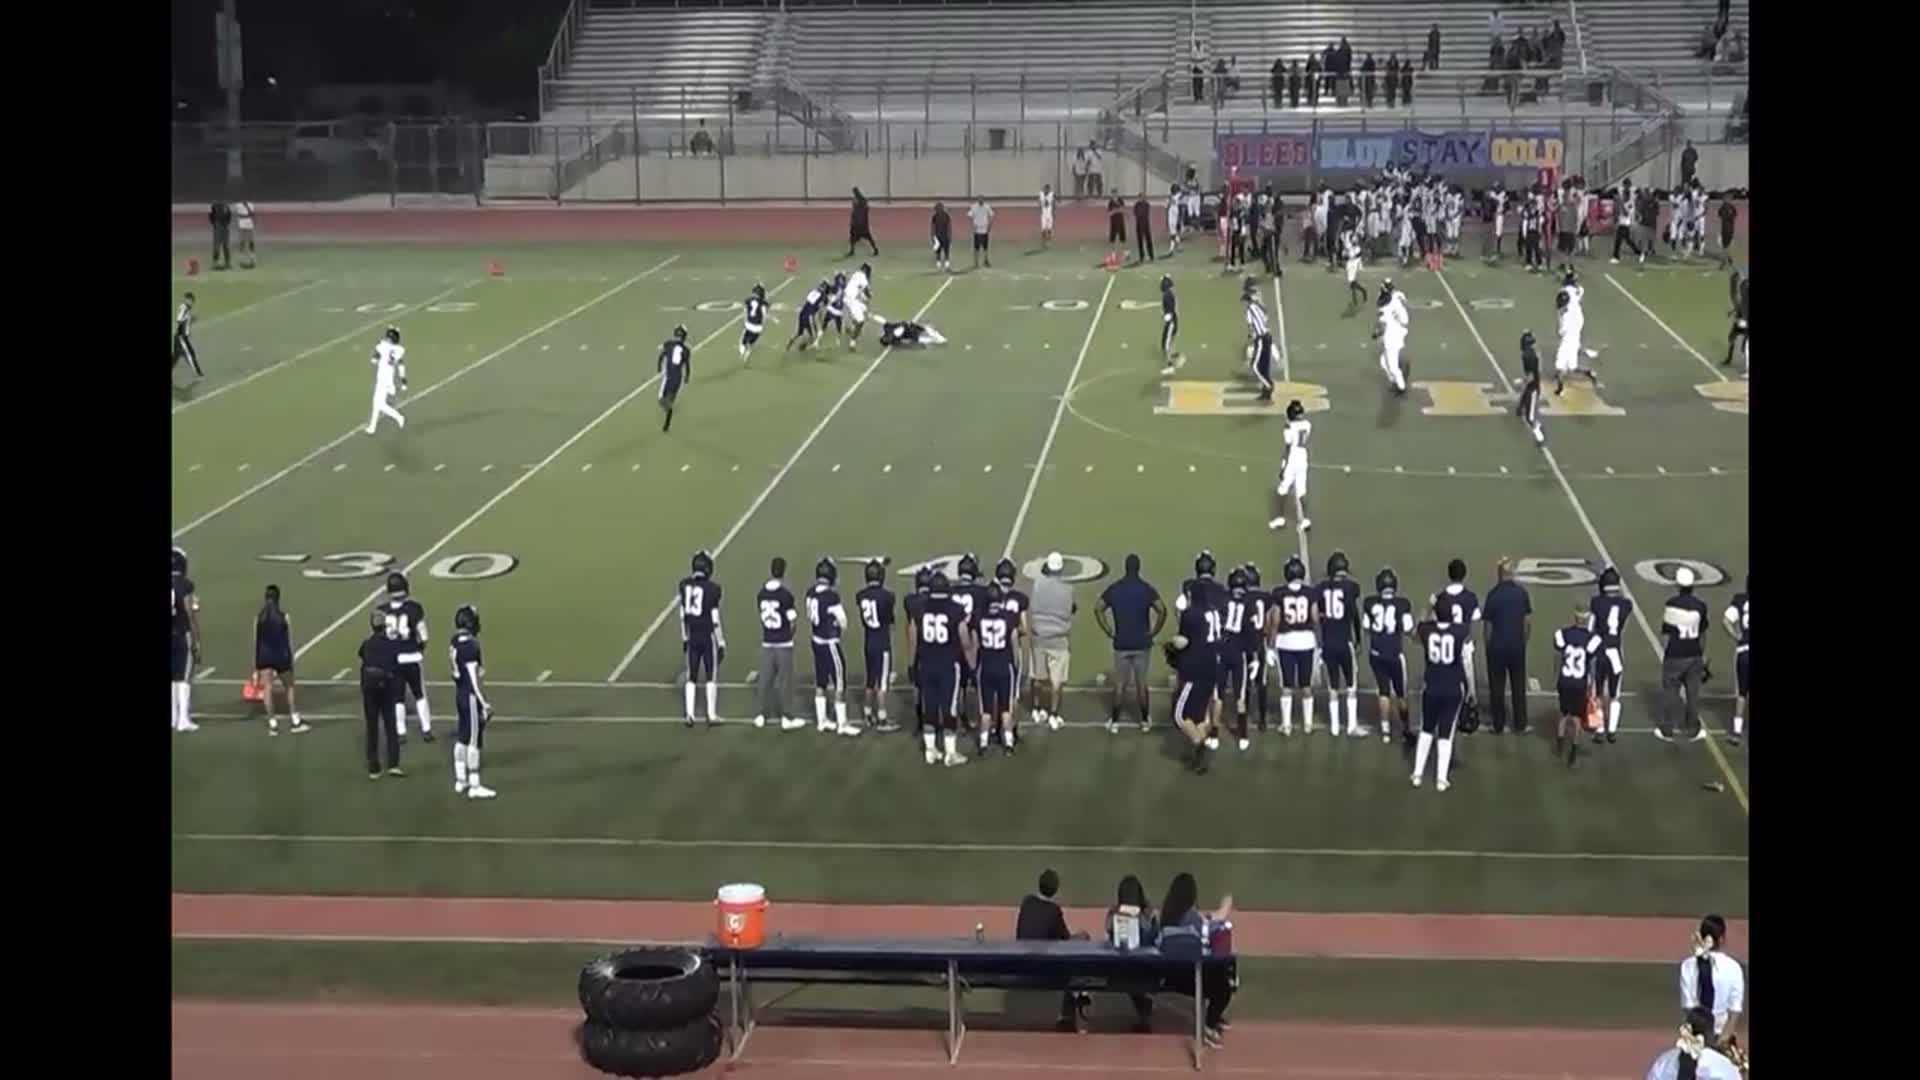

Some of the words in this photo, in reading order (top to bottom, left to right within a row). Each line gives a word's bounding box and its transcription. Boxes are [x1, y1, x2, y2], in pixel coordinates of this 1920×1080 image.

[1403, 139, 1481, 164] STAY
[685, 585, 704, 616] 13
[760, 600, 782, 629] 25
[861, 599, 881, 628] 21
[1283, 596, 1308, 625] 58
[1323, 589, 1345, 620] 16
[922, 613, 949, 643] 66
[980, 618, 1006, 649] 52
[1371, 603, 1397, 634] 34
[1607, 605, 1619, 636] 4
[1428, 632, 1455, 664] 60
[1562, 645, 1586, 679] 33
